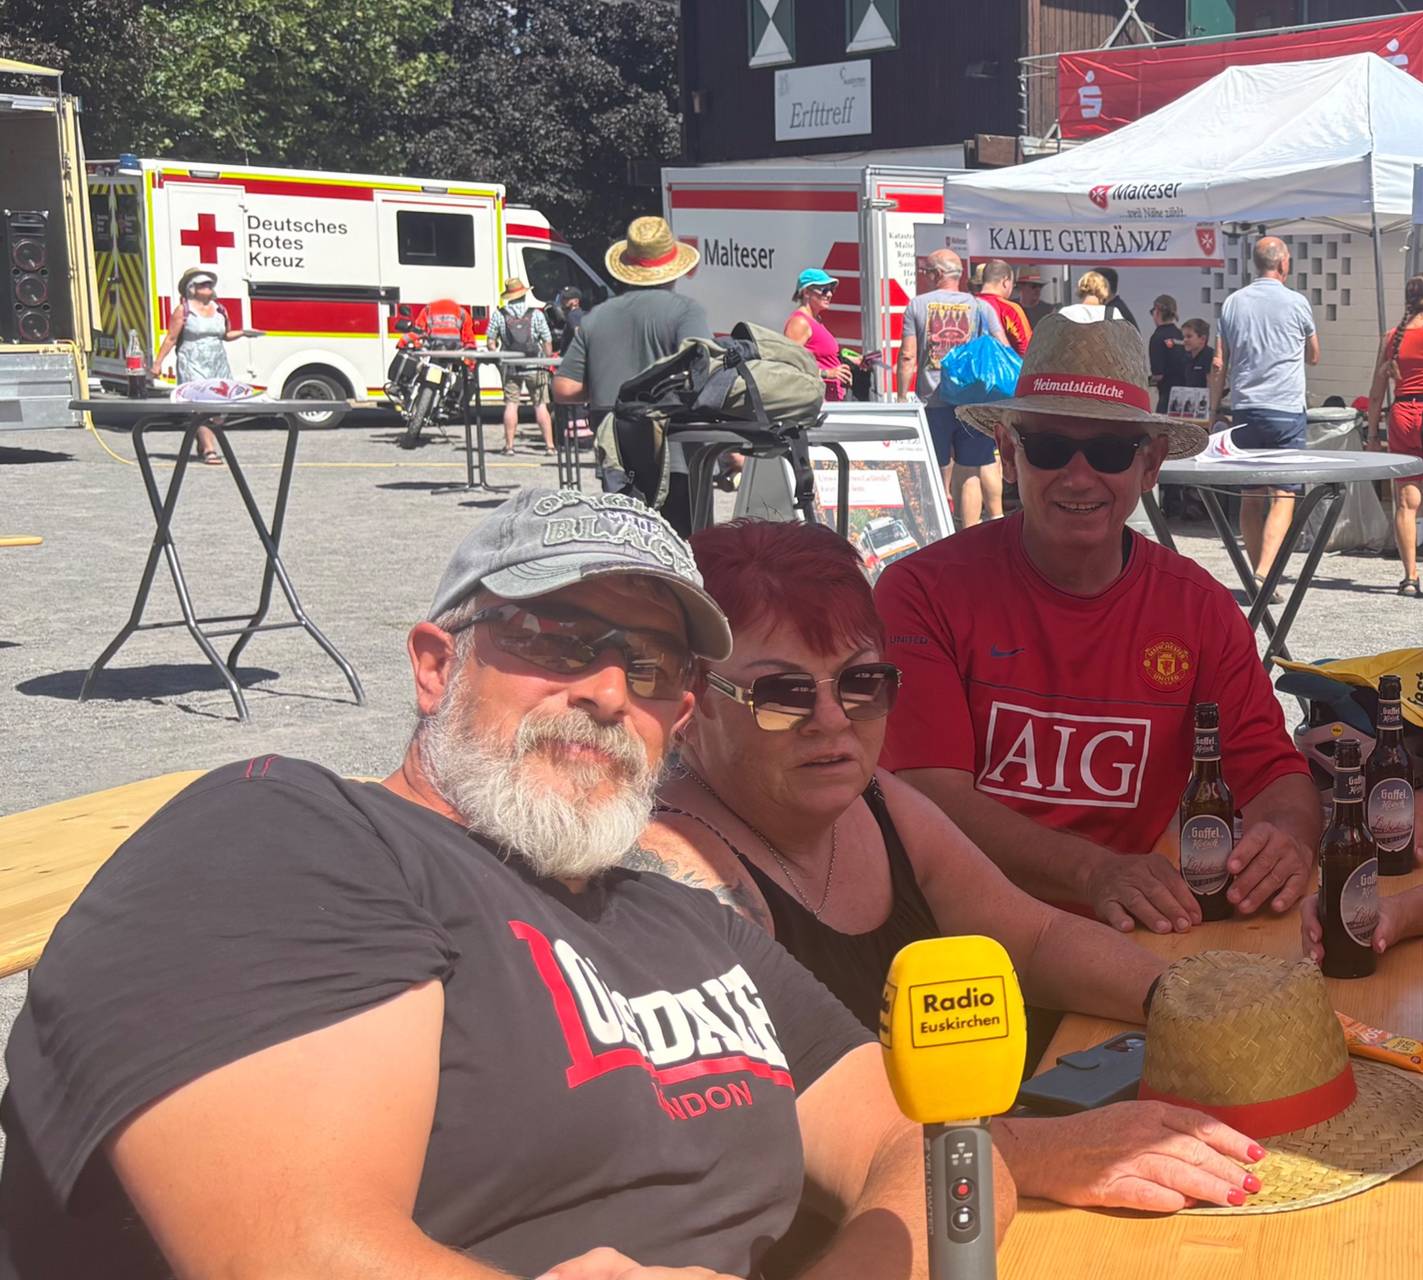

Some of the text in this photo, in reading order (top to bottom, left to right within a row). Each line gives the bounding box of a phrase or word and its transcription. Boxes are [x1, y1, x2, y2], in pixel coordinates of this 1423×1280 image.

[789, 96, 856, 129] Erfttreff
[1112, 182, 1182, 201] Malteser
[247, 215, 348, 235] Deutsches
[249, 234, 304, 250] Rotes
[989, 227, 1054, 252] KALTE
[1058, 225, 1172, 254] GETRÄNKE
[249, 252, 305, 268] Kreuz
[704, 238, 775, 269] Malteser
[1033, 378, 1124, 399] Heimatstädtche
[986, 718, 1137, 797] AIG
[1380, 788, 1408, 801] Gaffel
[1191, 826, 1221, 840] Gaffel
[923, 987, 995, 1014] Radio
[920, 1014, 1000, 1034] Euskirchen
